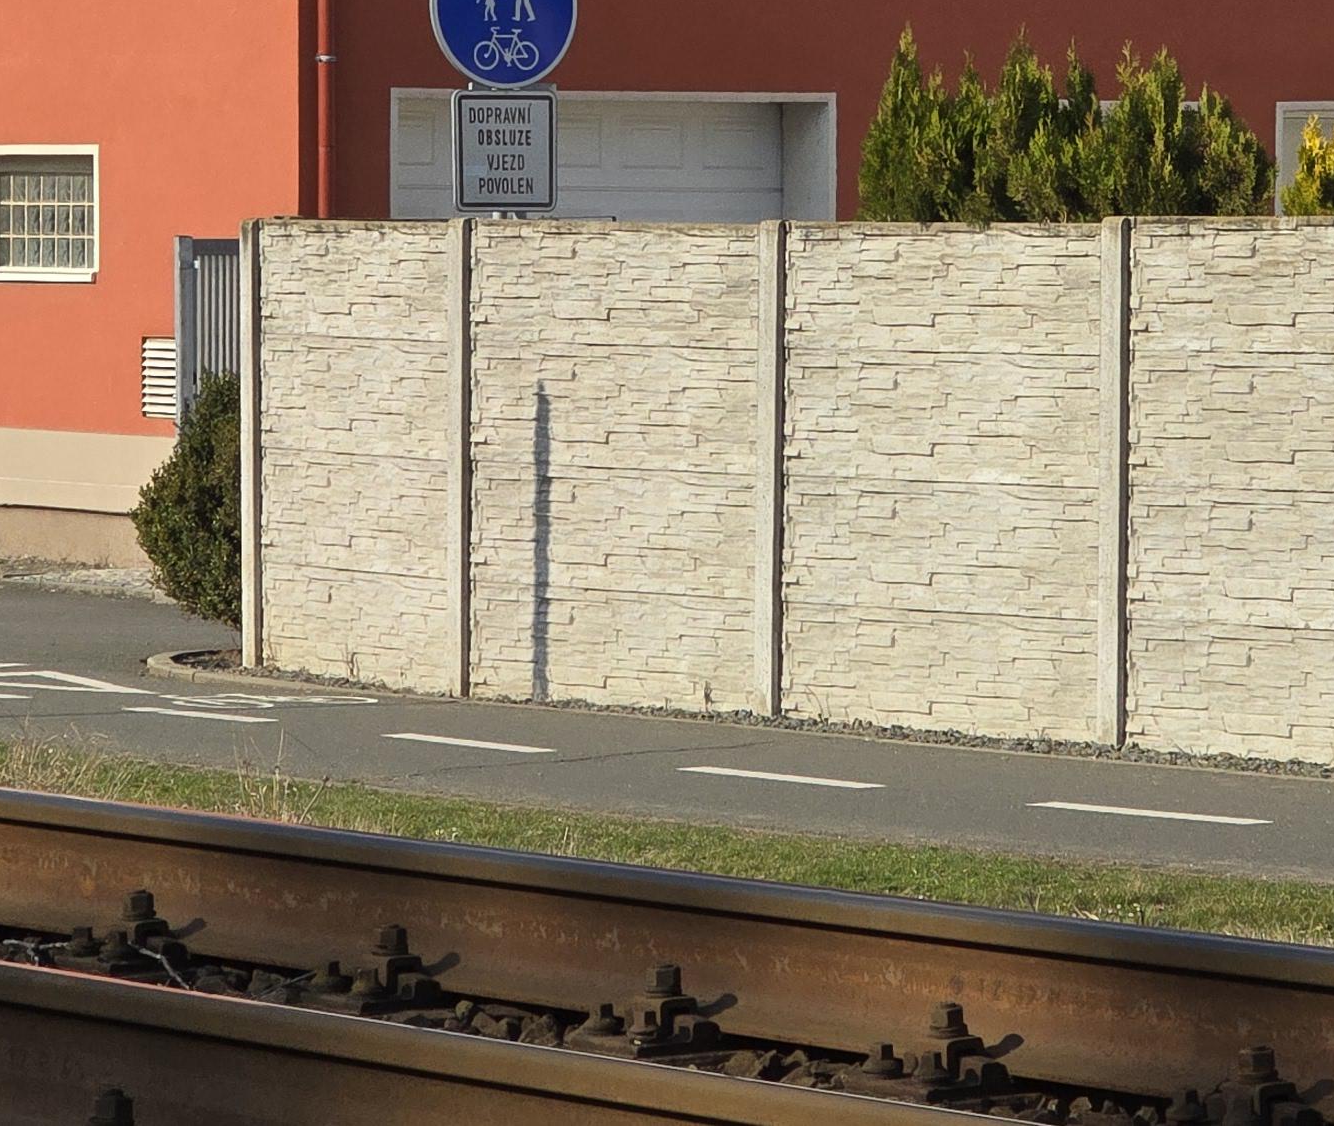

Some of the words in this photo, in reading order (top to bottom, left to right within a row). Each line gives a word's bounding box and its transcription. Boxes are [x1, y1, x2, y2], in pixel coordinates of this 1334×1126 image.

[468, 103, 532, 124] DOPRAVNÍ
[477, 129, 532, 146] OBSLUZE
[487, 154, 525, 171] VJEZD
[478, 177, 534, 195] POVOLEN
